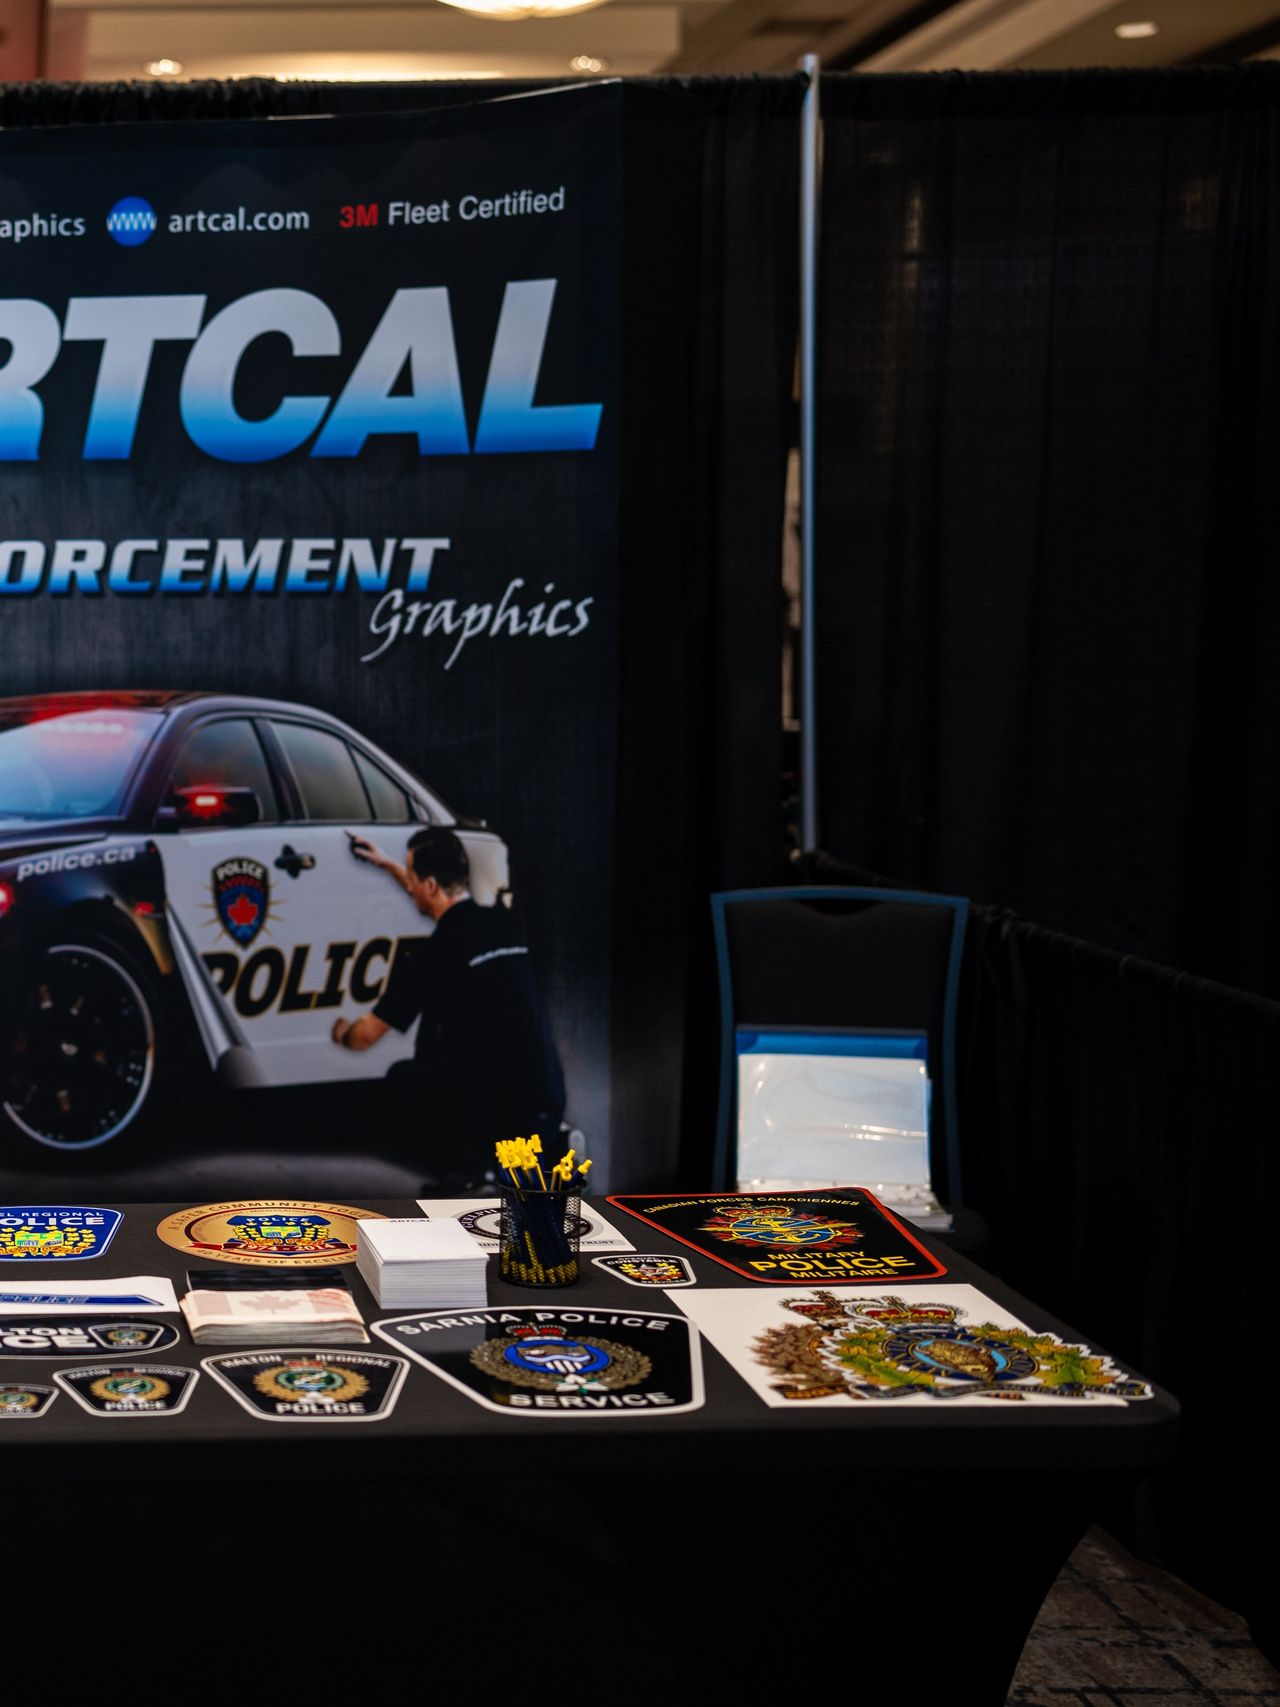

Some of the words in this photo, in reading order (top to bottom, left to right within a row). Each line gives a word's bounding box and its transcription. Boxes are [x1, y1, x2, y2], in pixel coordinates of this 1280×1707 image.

[339, 204, 378, 228] 3M
[387, 200, 451, 226] Fleet
[458, 186, 566, 221] Certified
[168, 206, 310, 233] artcal.com
[361, 579, 595, 670] Graphics
[16, 845, 137, 882] police.ca
[215, 861, 264, 882] POLICE
[201, 934, 431, 1019] POLIC
[643, 1201, 699, 1213] CANADIAN
[698, 1197, 754, 1205] FORCES
[759, 1197, 860, 1206] CANADIENNES
[172, 1210, 208, 1225] SAFER
[208, 1202, 323, 1212] COMMUNITY
[328, 1206, 378, 1219] TOGET
[215, 1254, 261, 1263] YEARS
[294, 1255, 356, 1264] EXCELLE
[766, 1251, 866, 1260] MILITARY
[749, 1256, 916, 1272] POLICE
[788, 1268, 899, 1278] MILITAIRE
[396, 1313, 523, 1335] SARNIA
[535, 1312, 671, 1331] POLICE
[220, 1354, 282, 1368] HALTON
[315, 1354, 391, 1368] REGIONAL
[104, 1400, 168, 1411] POLICE
[275, 1402, 366, 1414] POLICE
[509, 1392, 675, 1408] SERVICE
